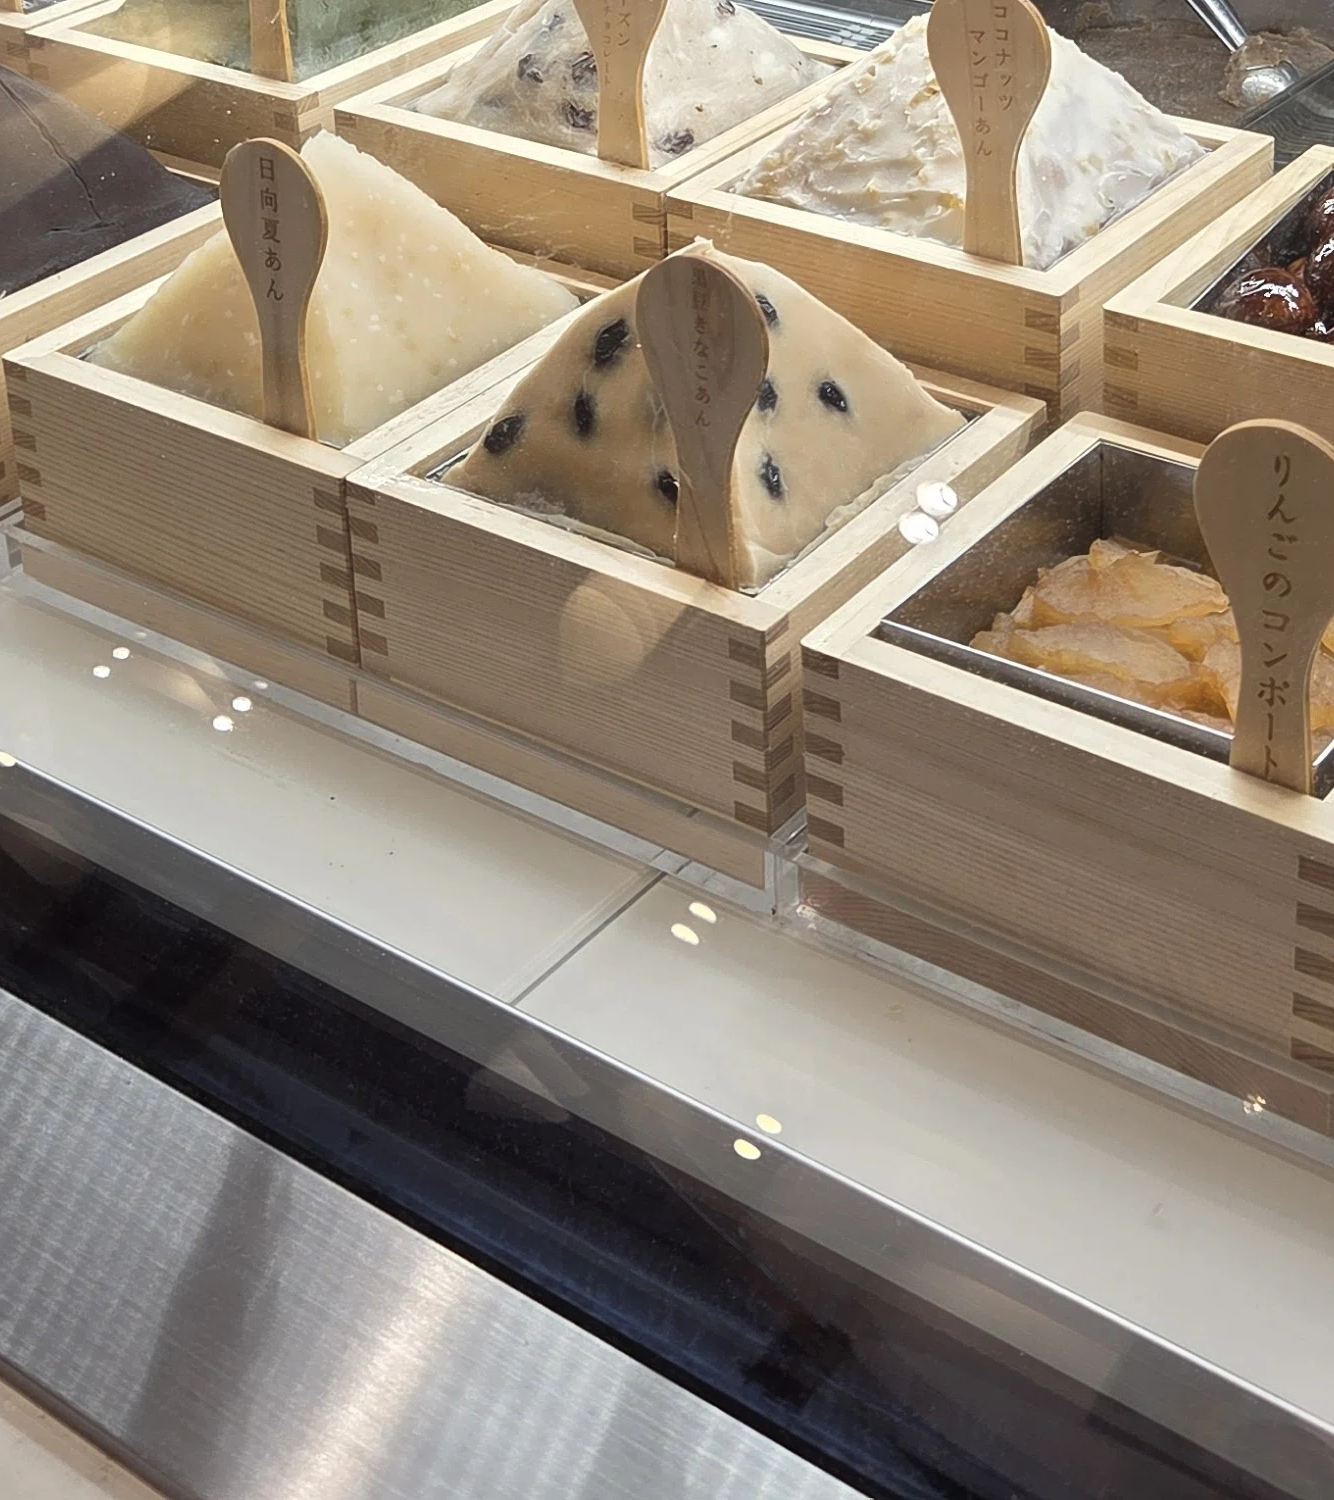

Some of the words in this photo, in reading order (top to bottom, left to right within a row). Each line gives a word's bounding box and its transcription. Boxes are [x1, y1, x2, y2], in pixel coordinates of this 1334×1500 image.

[969, 29, 993, 157] マンゴーあん
[993, 4, 1017, 112] ココナッツ
[259, 156, 284, 301] 日向夏あん
[1257, 454, 1299, 780] りんごのコンポート
